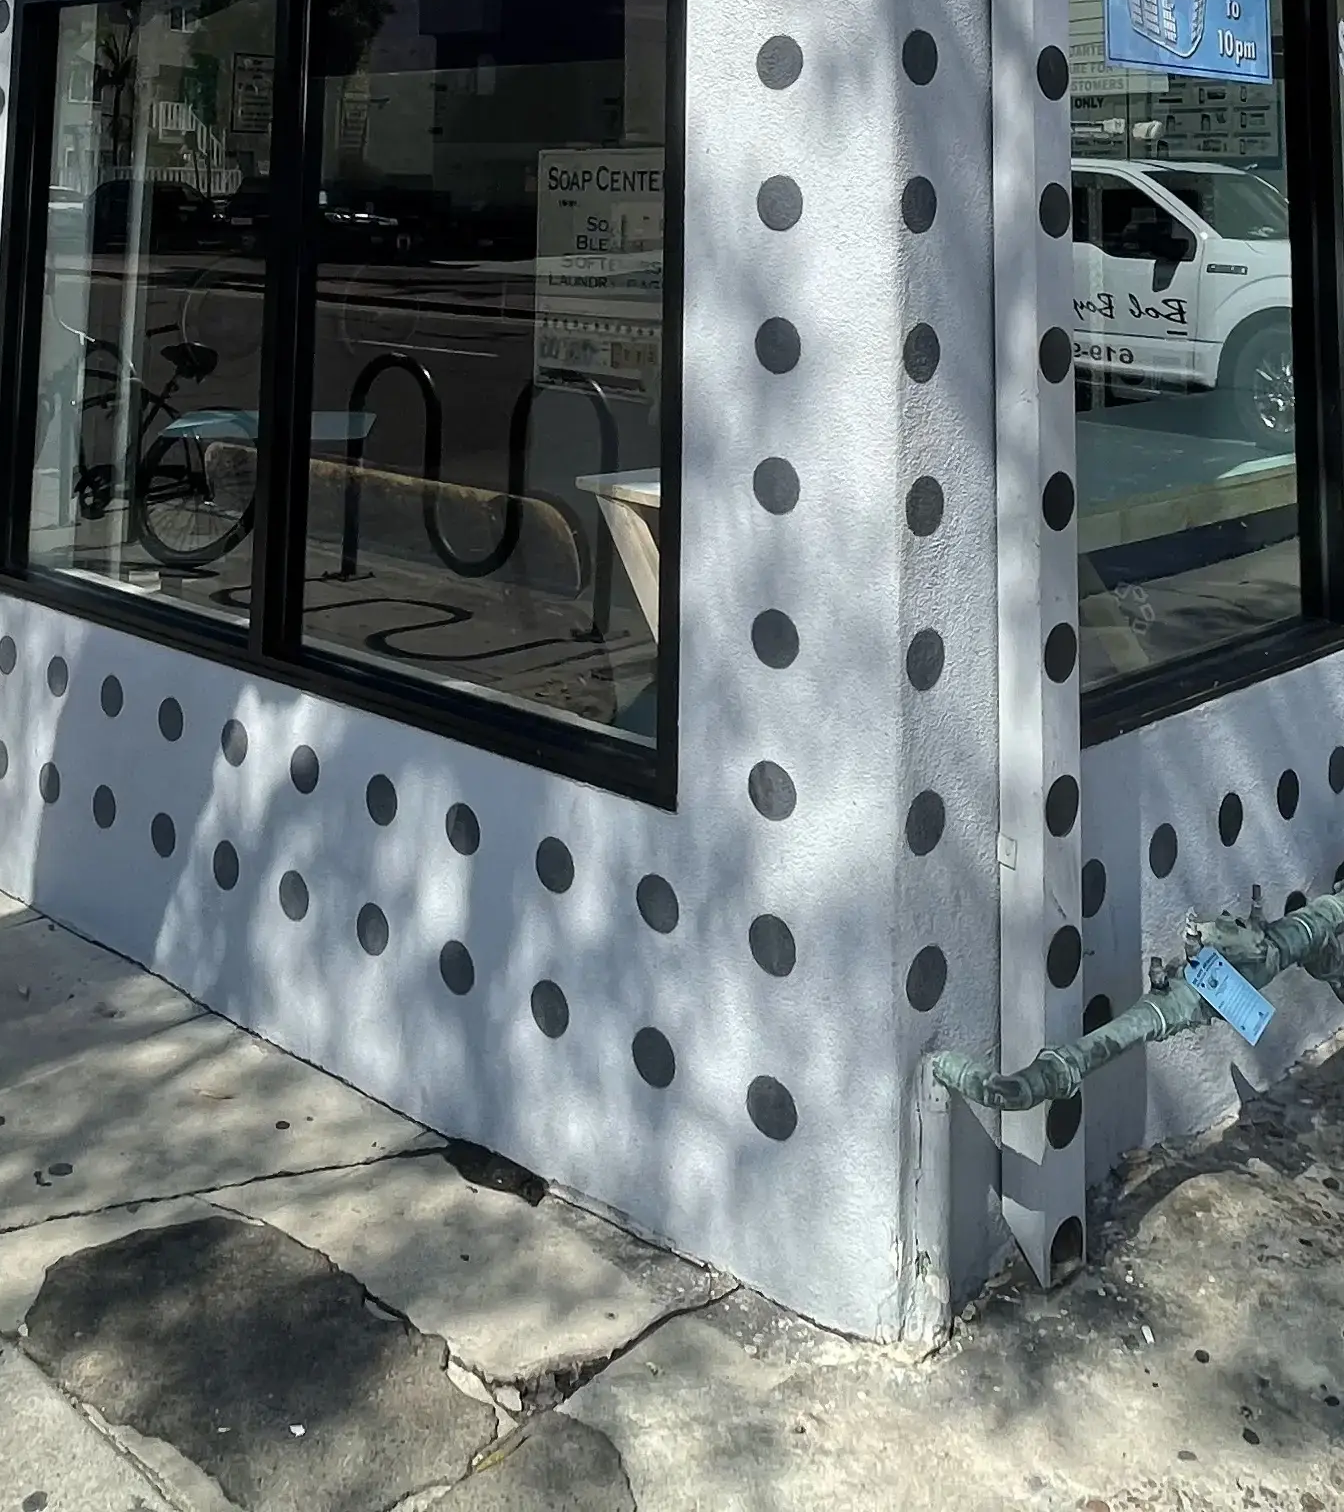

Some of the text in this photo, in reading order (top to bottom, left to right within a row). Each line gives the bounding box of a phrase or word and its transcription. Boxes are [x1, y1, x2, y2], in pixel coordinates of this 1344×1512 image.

[1217, 29, 1257, 66] 10pm
[1074, 97, 1104, 109] ONLY
[548, 165, 662, 193] SOAP CENTE
[548, 274, 616, 289] LAUNDR
